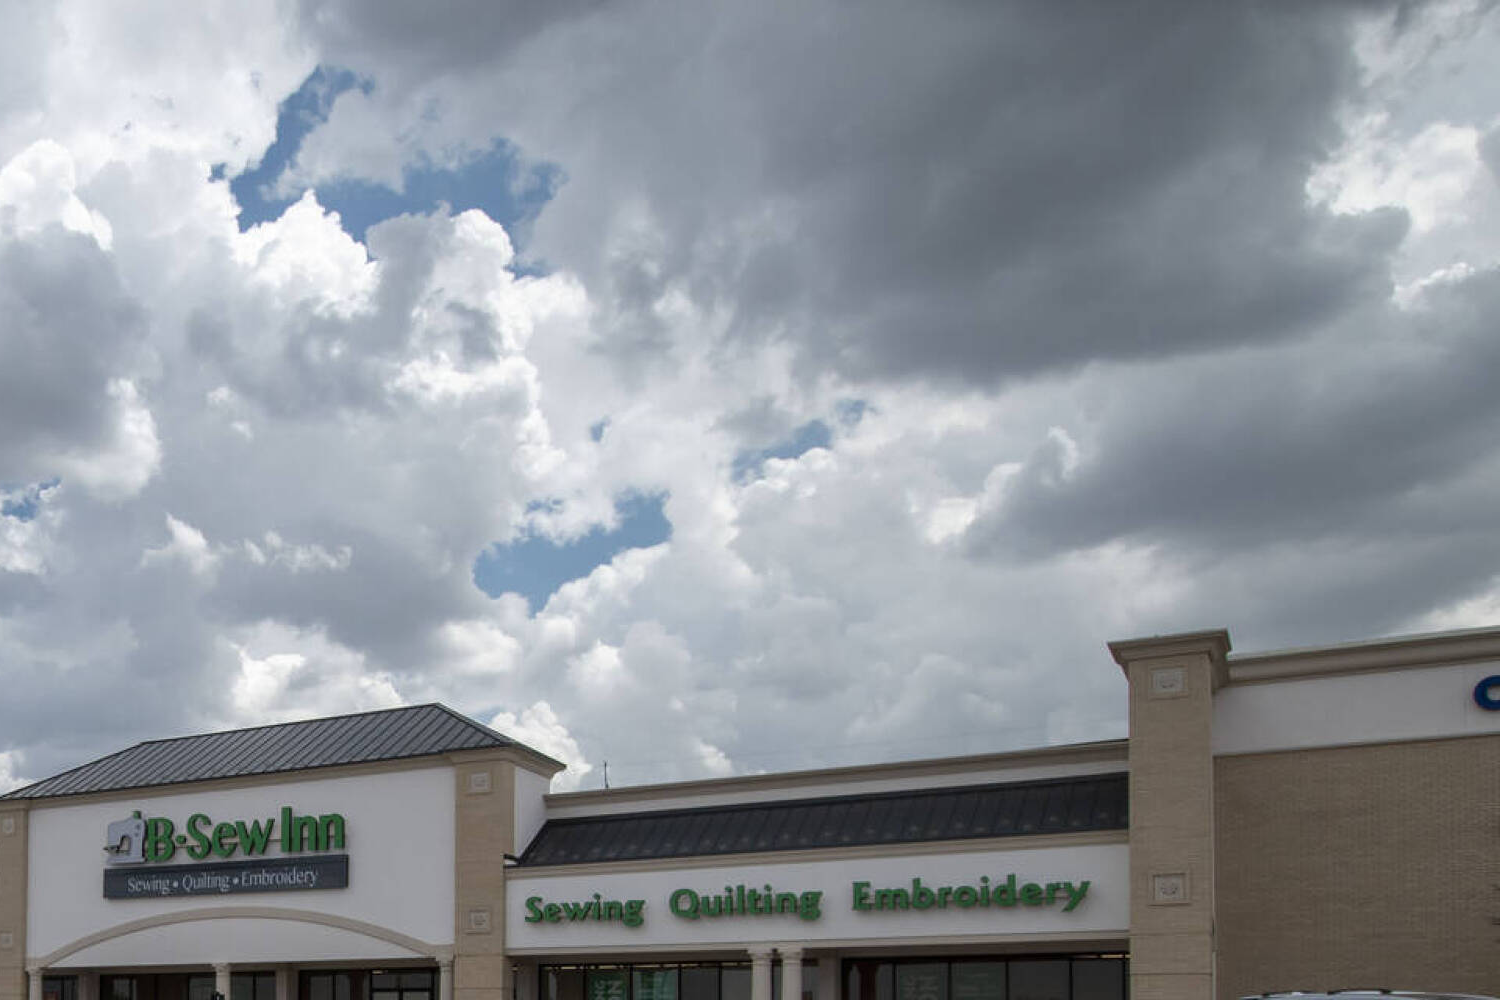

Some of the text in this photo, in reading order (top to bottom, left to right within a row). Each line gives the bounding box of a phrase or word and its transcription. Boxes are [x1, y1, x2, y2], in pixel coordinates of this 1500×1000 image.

[280, 806, 346, 852] Inn
[127, 864, 318, 895] Sewing Quilting Embroidery
[524, 874, 1091, 929] Sewing Quilting Embroidery
